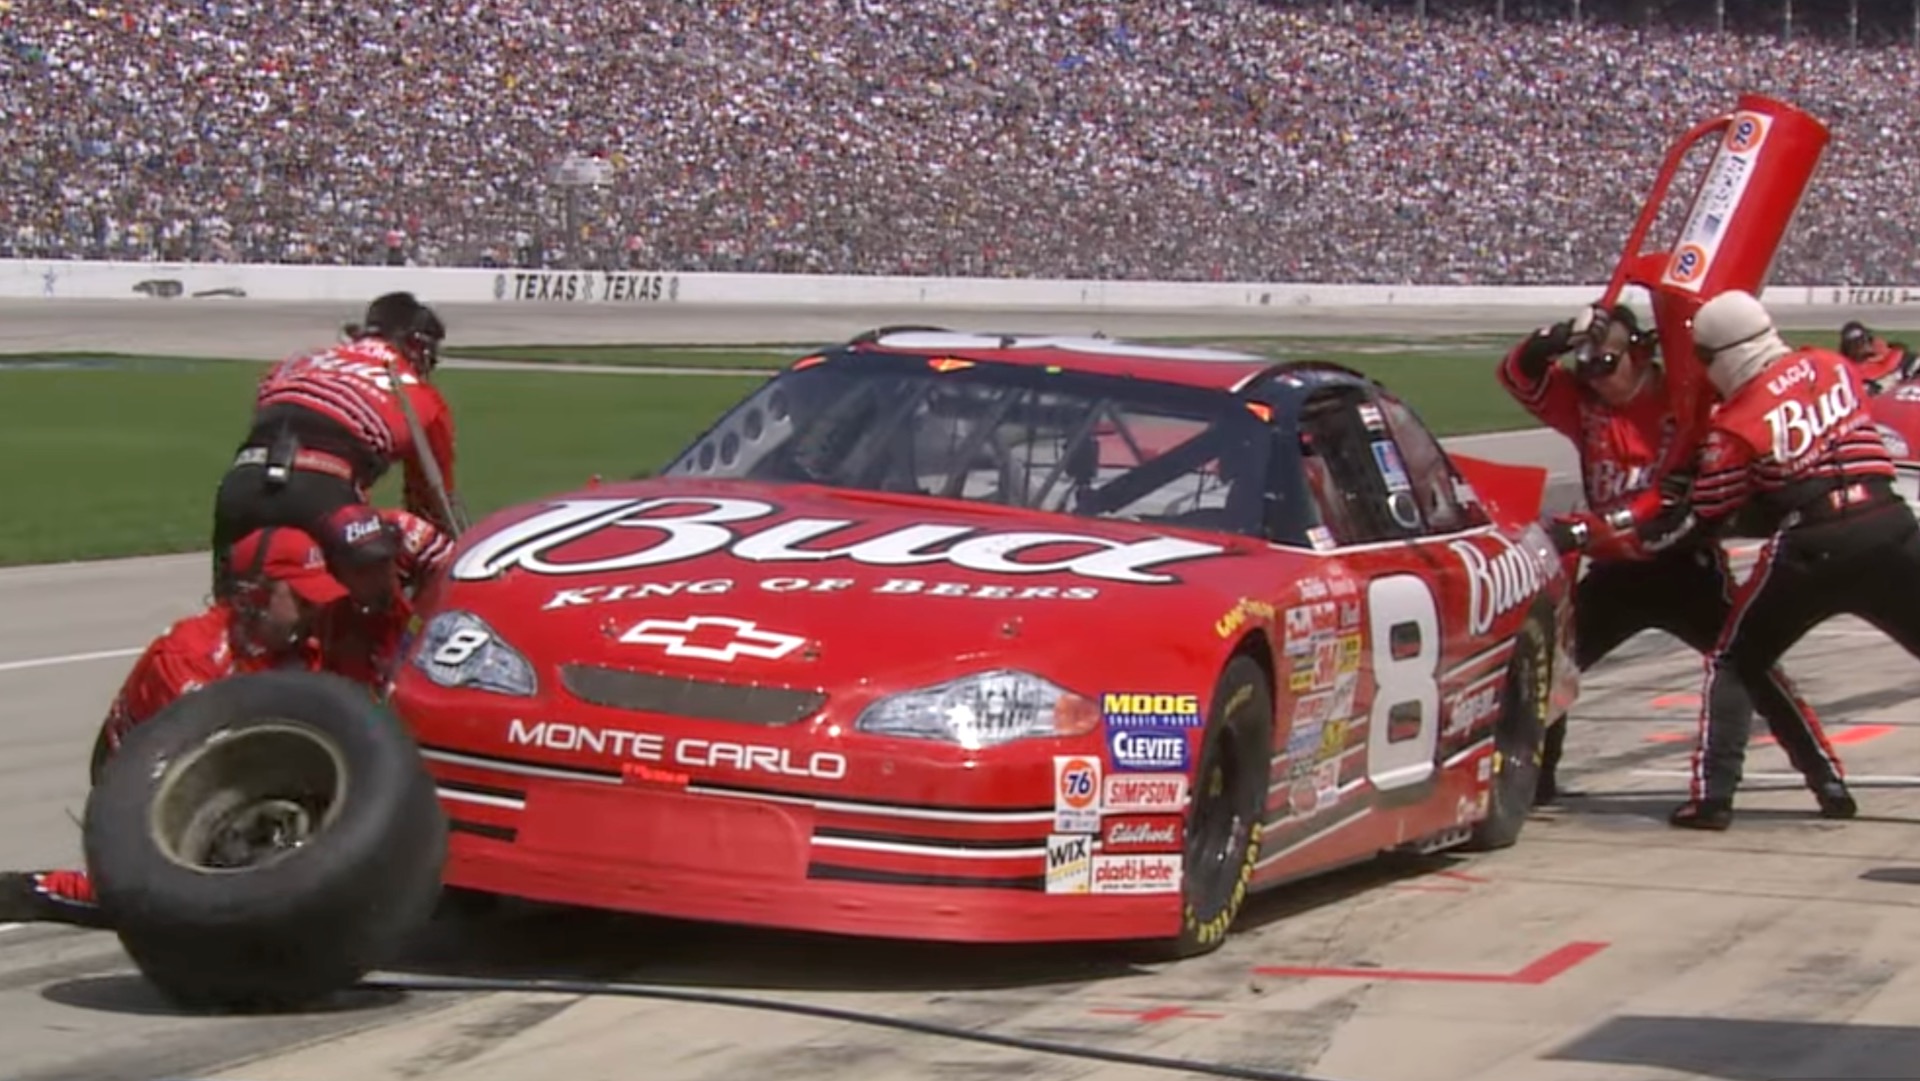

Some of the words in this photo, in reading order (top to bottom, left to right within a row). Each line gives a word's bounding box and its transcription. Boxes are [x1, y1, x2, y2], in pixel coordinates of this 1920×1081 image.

[1734, 122, 1753, 145] 76
[1677, 252, 1696, 276] 76
[515, 275, 578, 300] TEXAS
[603, 276, 662, 301] TEXAS
[1763, 363, 1858, 464] Bud
[345, 516, 381, 543] Bud
[452, 497, 1226, 584] Bud
[541, 578, 735, 610] KING
[759, 578, 855, 593] OF
[873, 578, 1099, 600] BEERS
[434, 629, 490, 665] 8
[1367, 573, 1441, 791] 8
[1104, 694, 1198, 714] MOOG
[508, 719, 664, 760] MONTE
[675, 739, 847, 779] CARLO
[1113, 731, 1184, 759] CLEVITE
[1067, 772, 1091, 795] 76
[1110, 780, 1179, 804] SIMPSON
[1048, 838, 1087, 869] WIX
